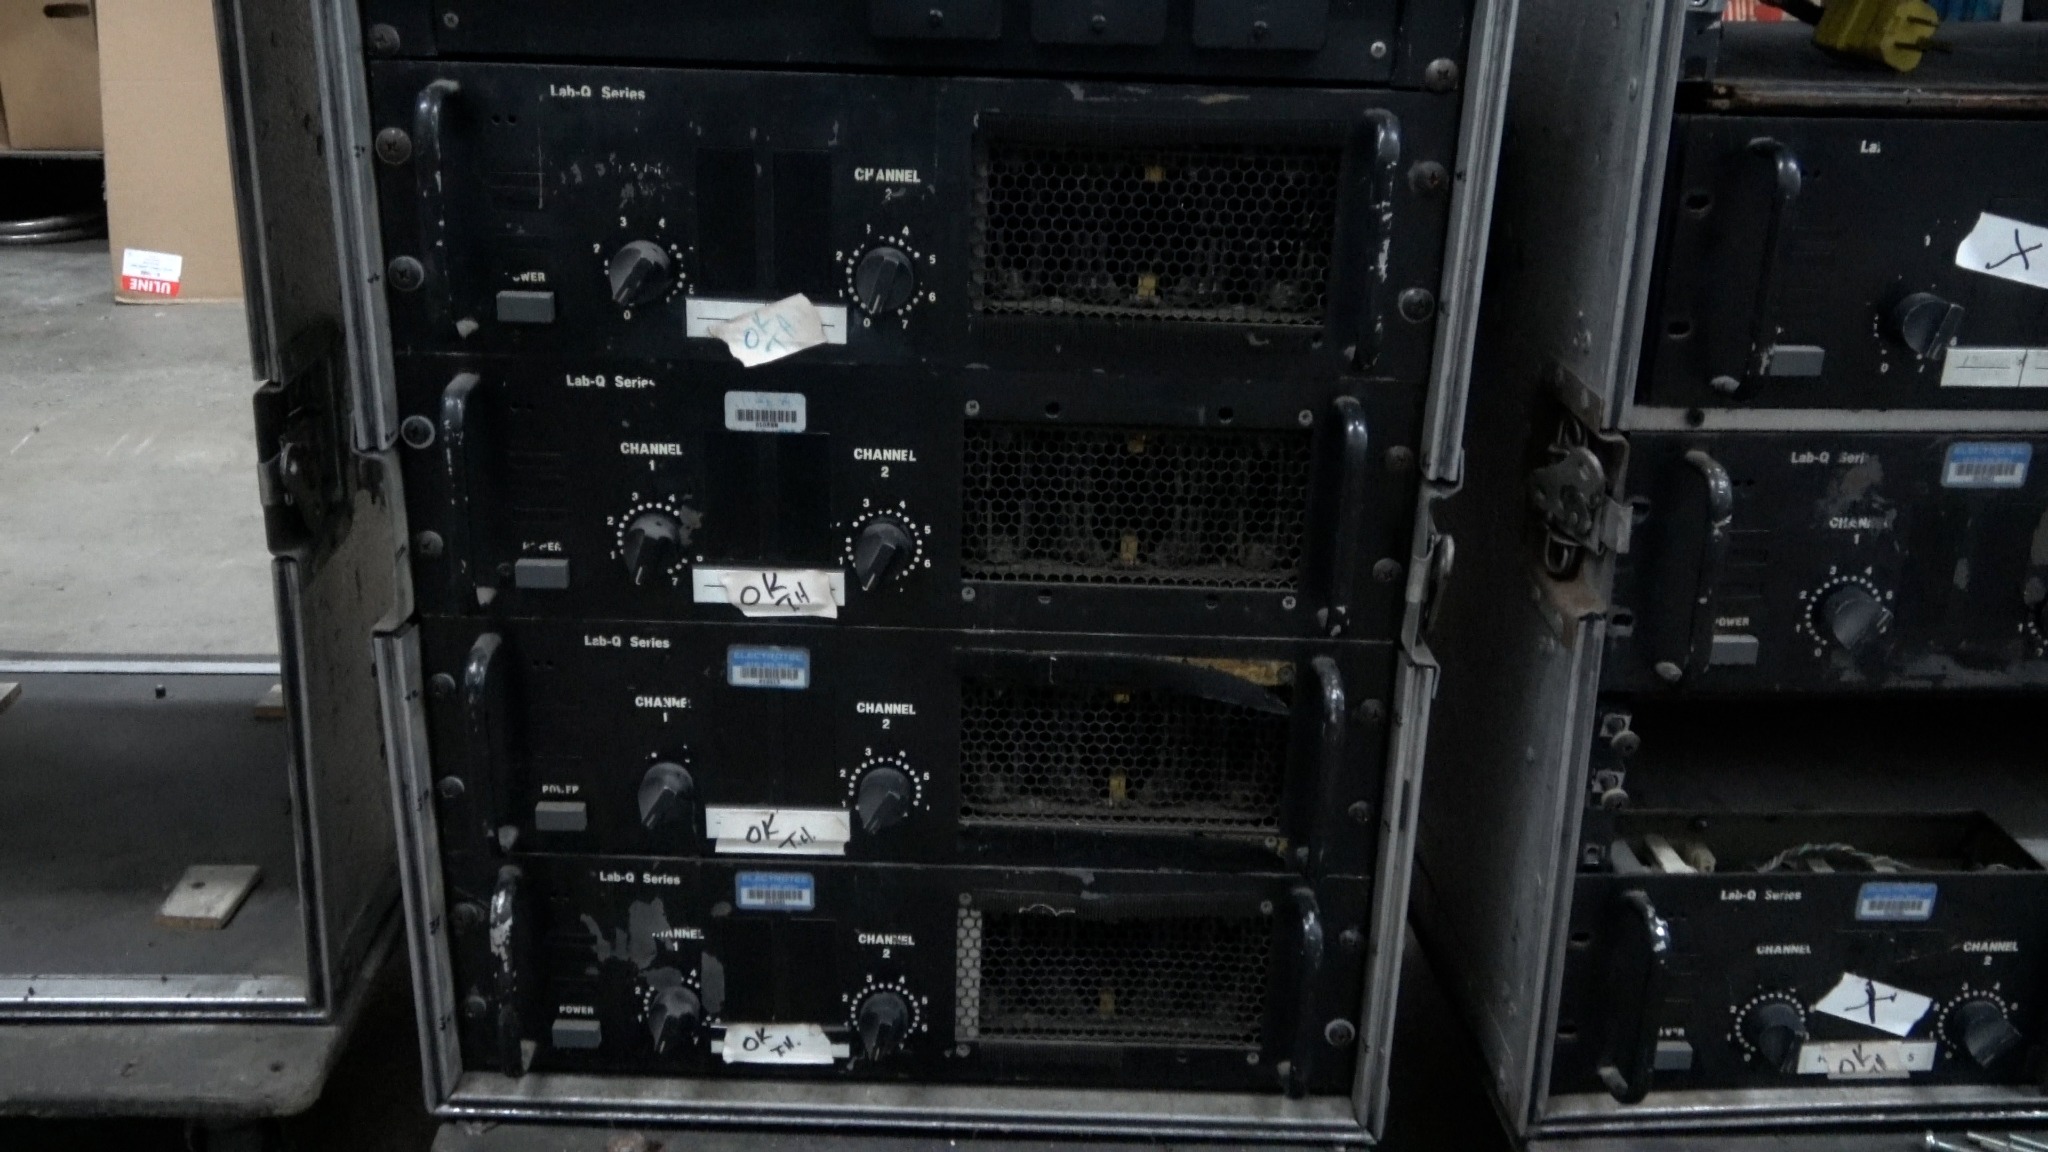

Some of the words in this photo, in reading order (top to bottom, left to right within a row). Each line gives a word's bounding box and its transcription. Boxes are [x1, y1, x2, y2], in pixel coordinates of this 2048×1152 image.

[550, 84, 592, 98] Lab-Q
[601, 85, 647, 100] Series
[620, 216, 628, 228] 3
[902, 225, 910, 236] 4
[836, 251, 843, 261] 2
[928, 254, 937, 265] 5
[129, 277, 171, 295] ULINE
[928, 291, 937, 303] 6
[623, 309, 632, 321] 0
[863, 318, 871, 329] 0
[566, 374, 606, 388] Lab-Q
[620, 441, 683, 456] CHANNEL
[853, 447, 917, 462] CHANNEL
[1791, 451, 1830, 464] Lab-Q
[649, 459, 656, 472] 1
[880, 465, 890, 478] 2
[631, 492, 639, 502] 3
[863, 498, 870, 508] 3
[606, 516, 614, 526] 2
[924, 525, 932, 535] 5
[1853, 533, 1860, 545] 1
[924, 559, 932, 569] 6
[740, 572, 787, 606] OK
[584, 635, 622, 648] Lab-Q
[630, 636, 670, 649] Series
[856, 702, 916, 716] CHANNEL
[882, 718, 891, 730] 2
[865, 747, 872, 757] 3
[840, 768, 847, 778] 2
[746, 813, 779, 844] OK
[599, 871, 635, 884] Lab-Q
[642, 872, 681, 886] Series
[1720, 889, 1757, 901] Lab-Q
[1764, 889, 1802, 901] Series
[673, 941, 679, 952] 1
[1963, 941, 2018, 953] CHANNEL
[882, 948, 891, 959] 2
[559, 1005, 594, 1015] POWER
[742, 1027, 773, 1052] OK
